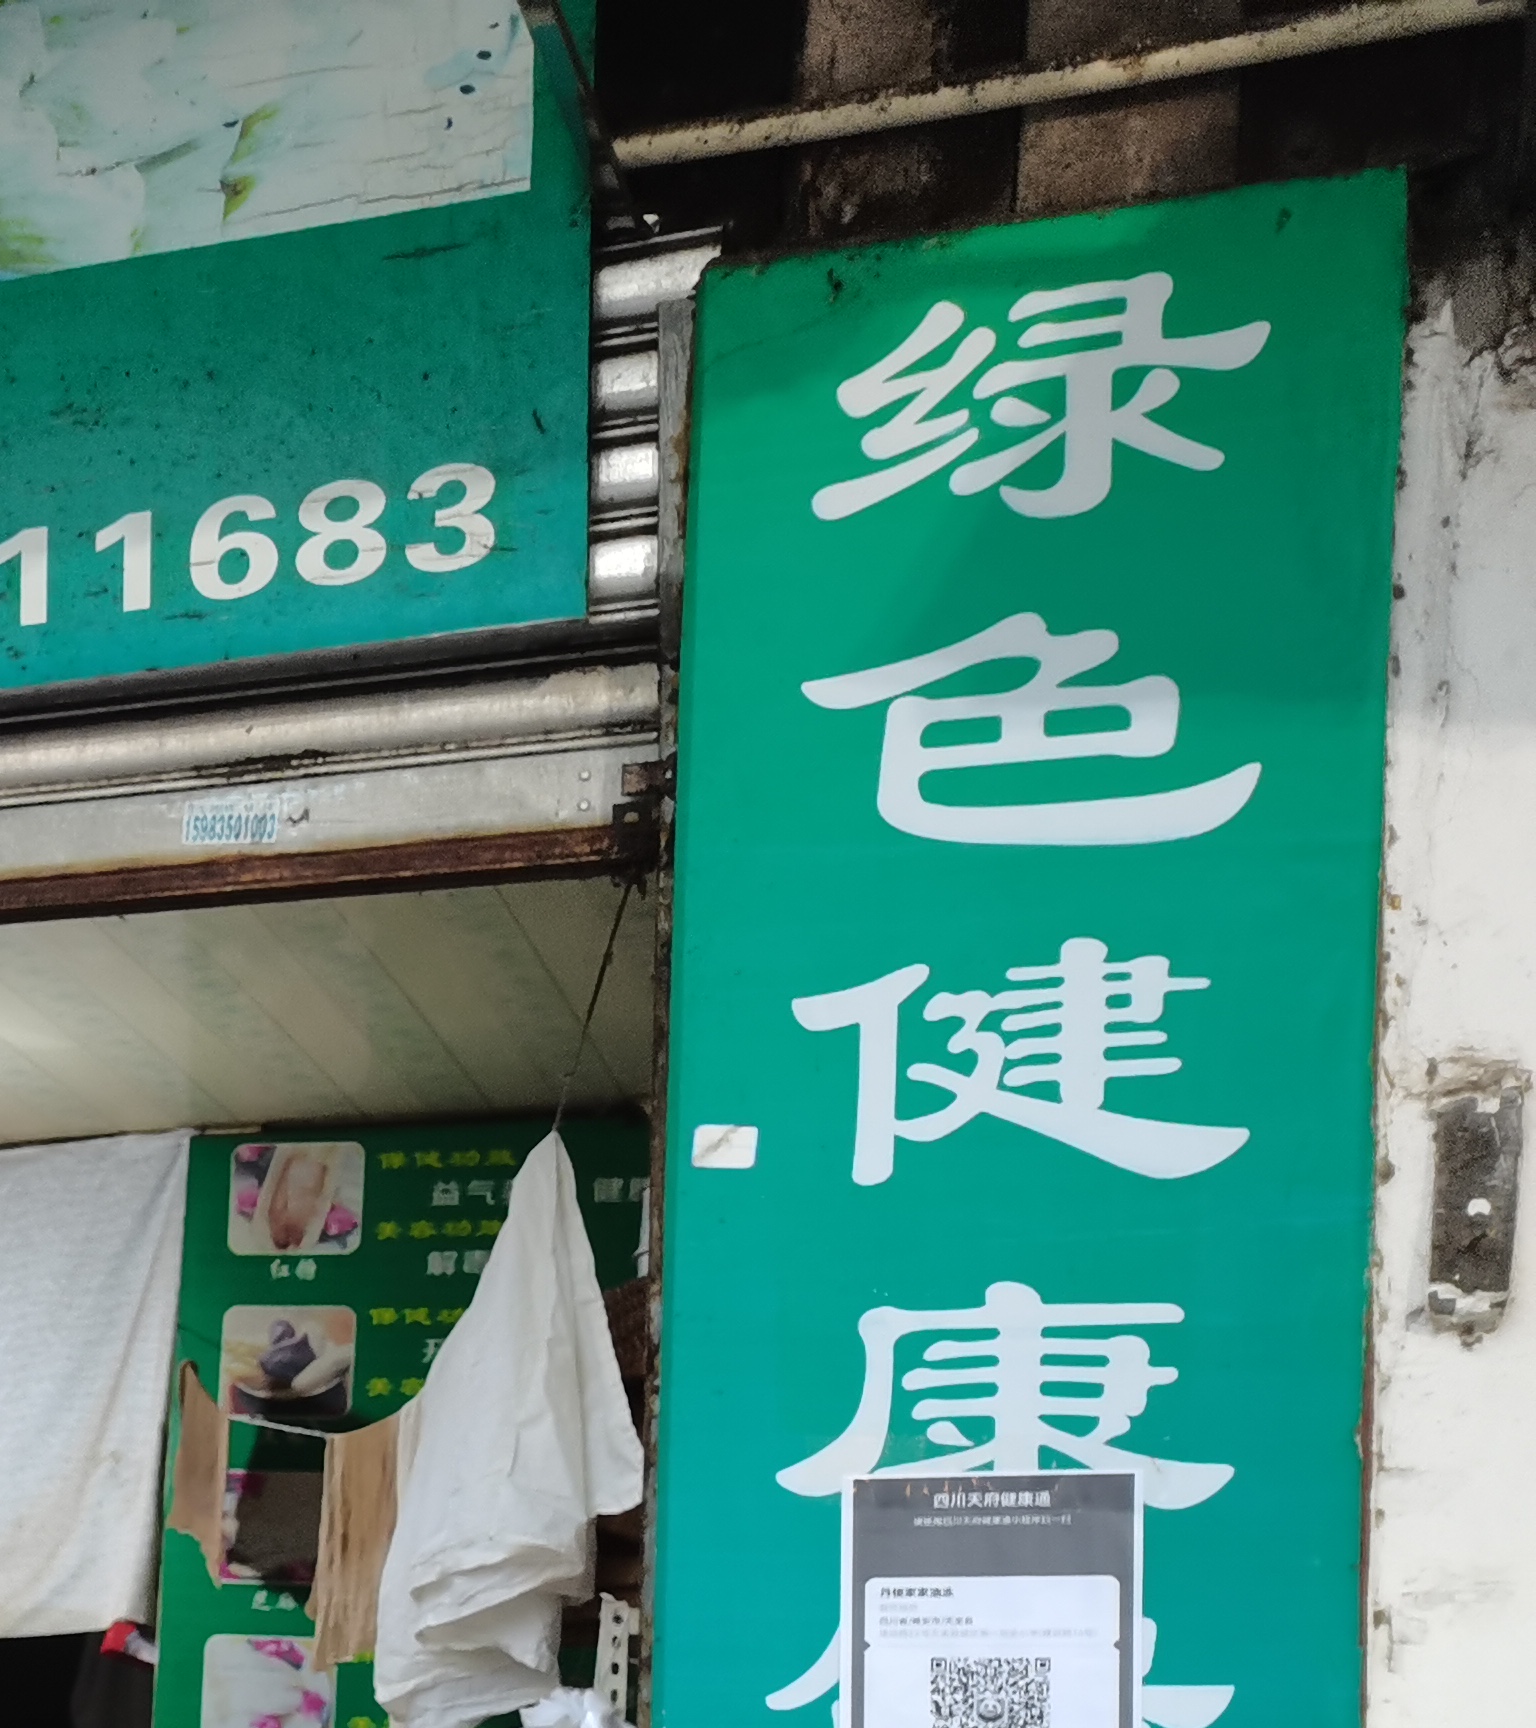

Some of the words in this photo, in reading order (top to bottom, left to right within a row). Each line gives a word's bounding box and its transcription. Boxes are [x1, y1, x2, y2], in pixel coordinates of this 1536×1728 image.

[933, 1489, 1052, 1510] 四川天府健康通
